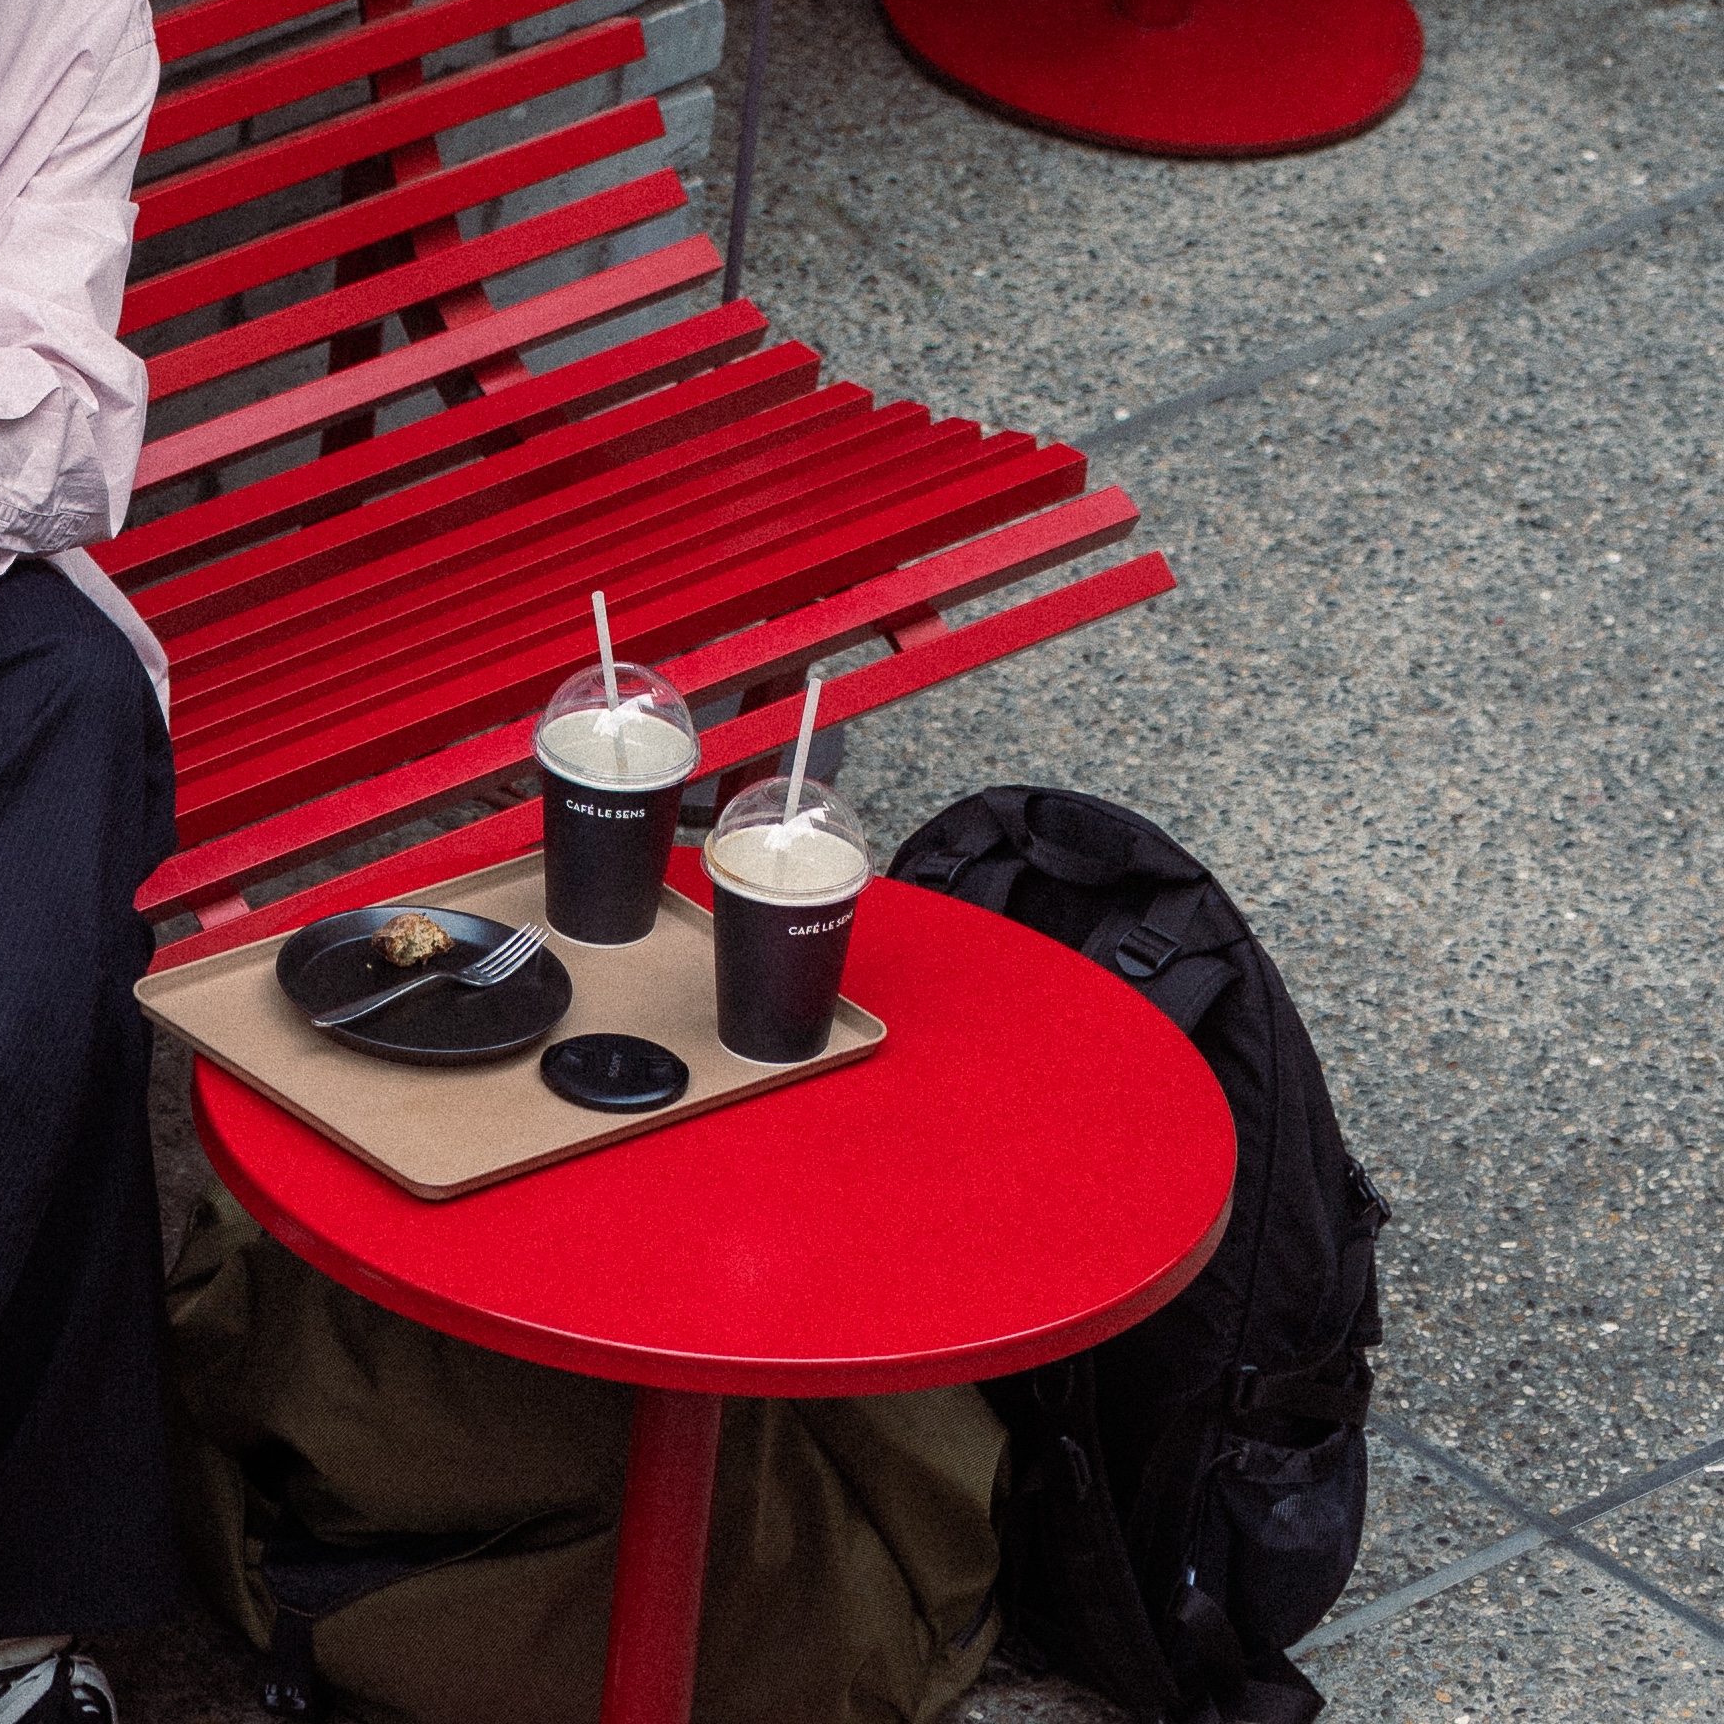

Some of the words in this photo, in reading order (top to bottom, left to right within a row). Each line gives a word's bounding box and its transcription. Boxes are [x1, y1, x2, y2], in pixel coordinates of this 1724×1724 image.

[565, 799, 594, 816] CAFÉ
[597, 808, 613, 819] LE
[615, 808, 646, 819] SENS
[788, 921, 820, 936] CAFÉ
[822, 920, 835, 932] LE
